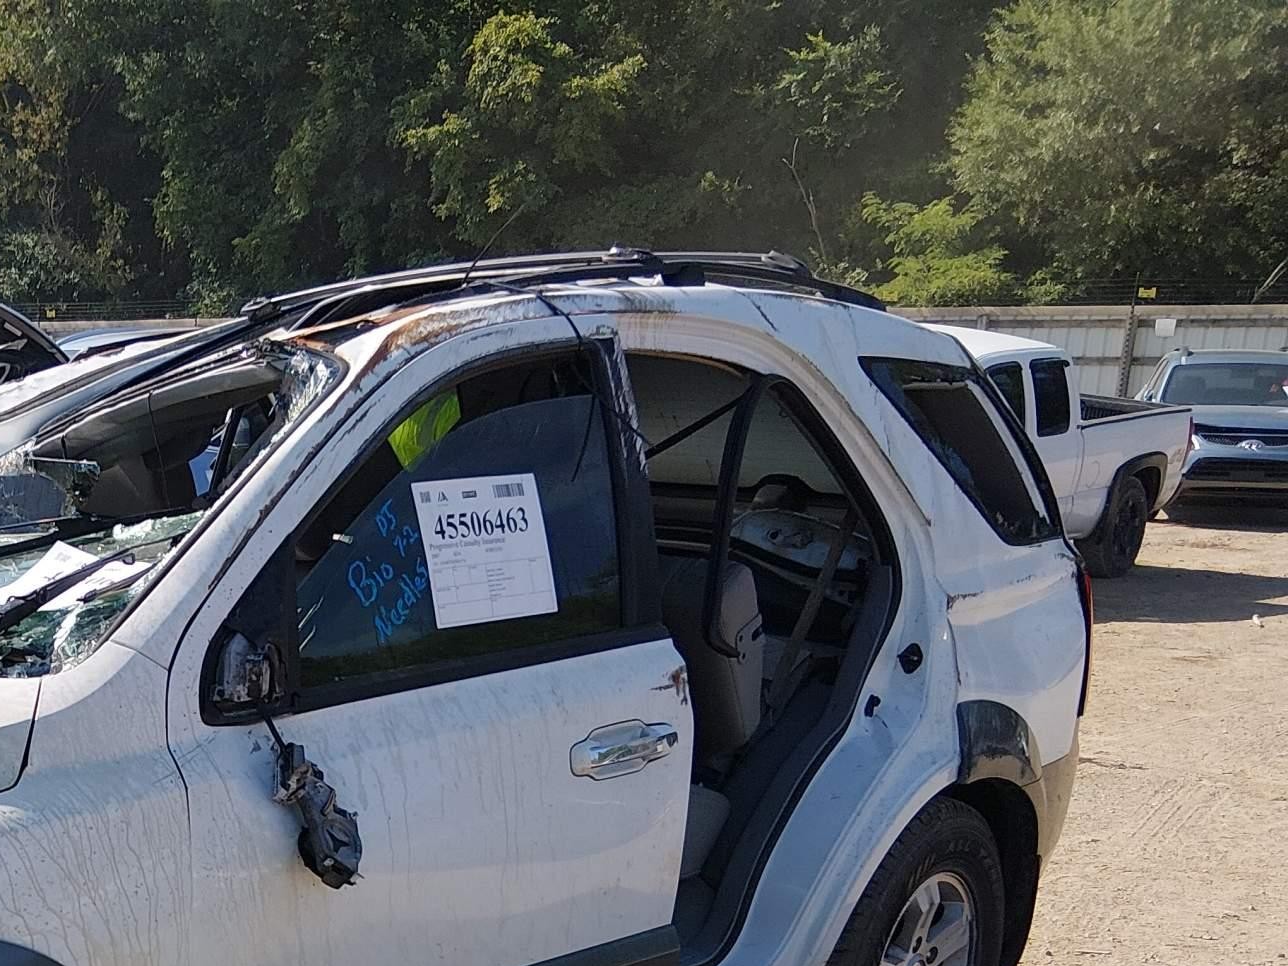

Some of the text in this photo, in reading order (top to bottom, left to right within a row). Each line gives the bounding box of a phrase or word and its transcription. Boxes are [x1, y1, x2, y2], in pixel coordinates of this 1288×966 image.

[434, 507, 529, 540] 45506463
[348, 556, 394, 607] Bio
[374, 557, 428, 643] Needles
